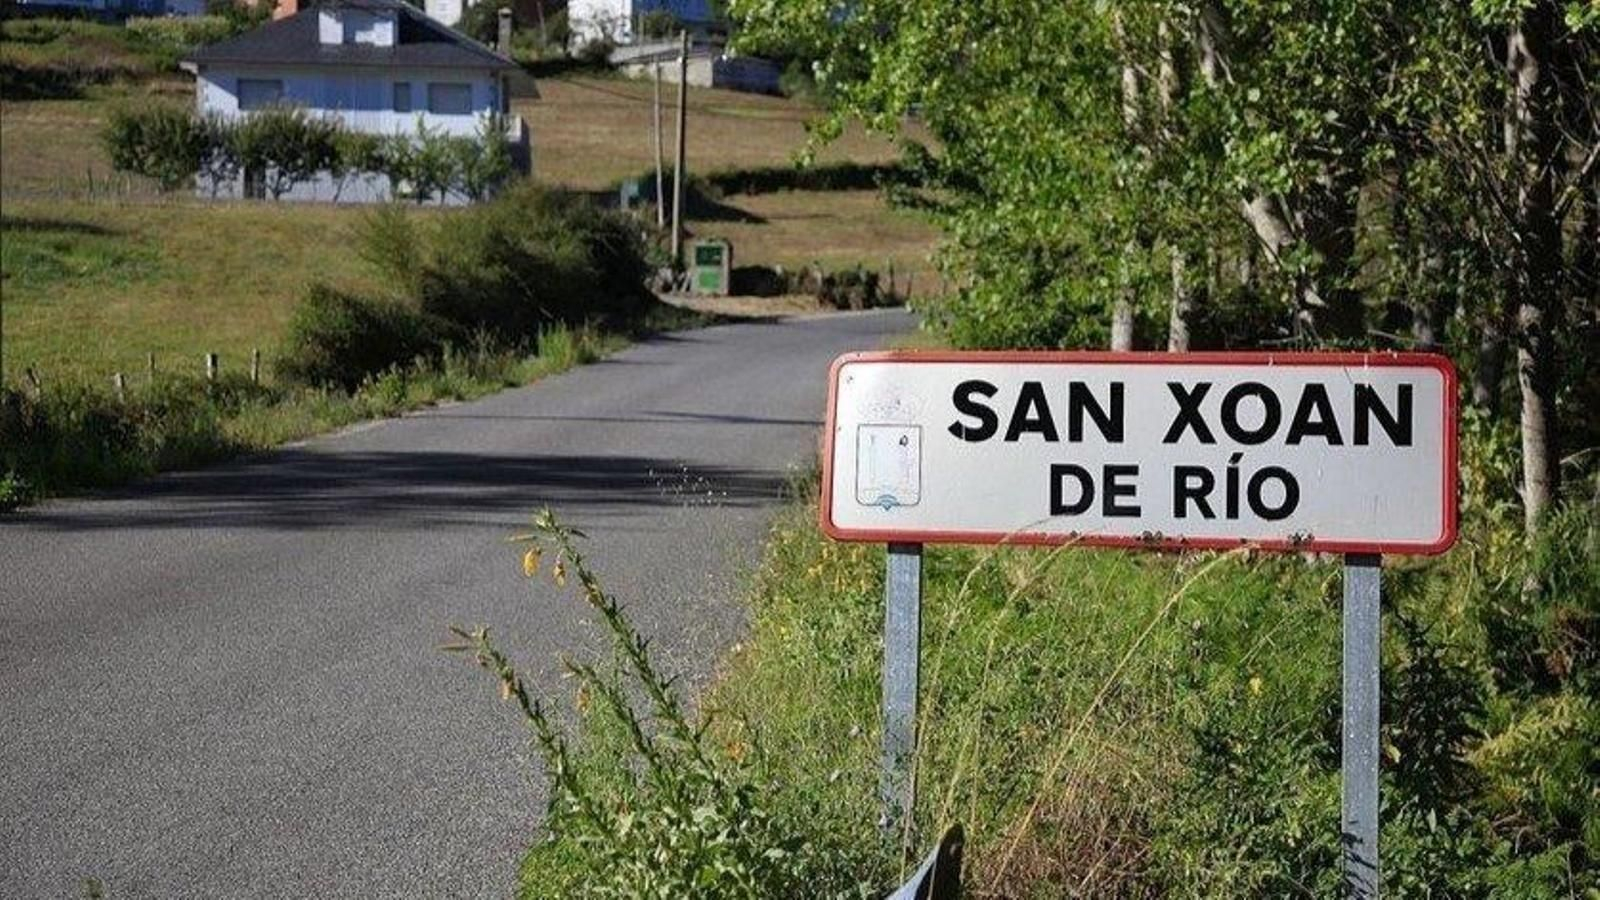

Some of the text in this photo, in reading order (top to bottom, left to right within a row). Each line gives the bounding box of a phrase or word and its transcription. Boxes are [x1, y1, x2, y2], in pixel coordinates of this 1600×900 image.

[948, 379, 1415, 447] SAN XOAN
[1049, 452, 1301, 522] DE RÍO
